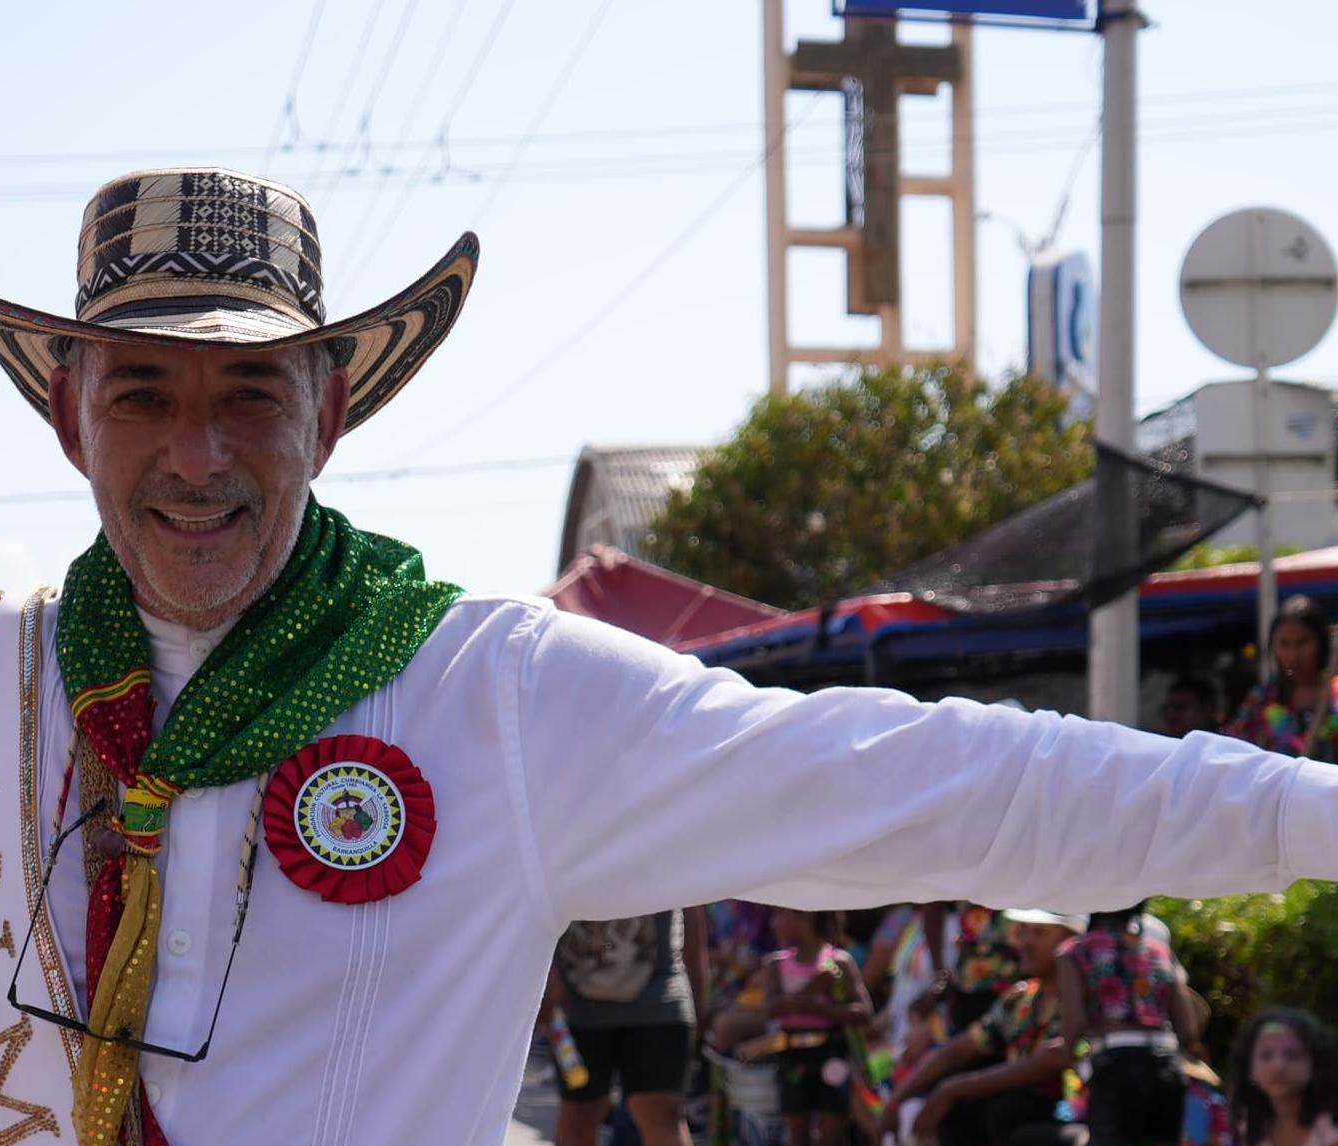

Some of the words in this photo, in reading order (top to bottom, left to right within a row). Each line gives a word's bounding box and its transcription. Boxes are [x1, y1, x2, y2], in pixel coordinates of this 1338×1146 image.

[314, 780, 339, 801] CULTURAL
[381, 802, 390, 830] SABROSA
[332, 840, 378, 856] BARRANQUILLA
